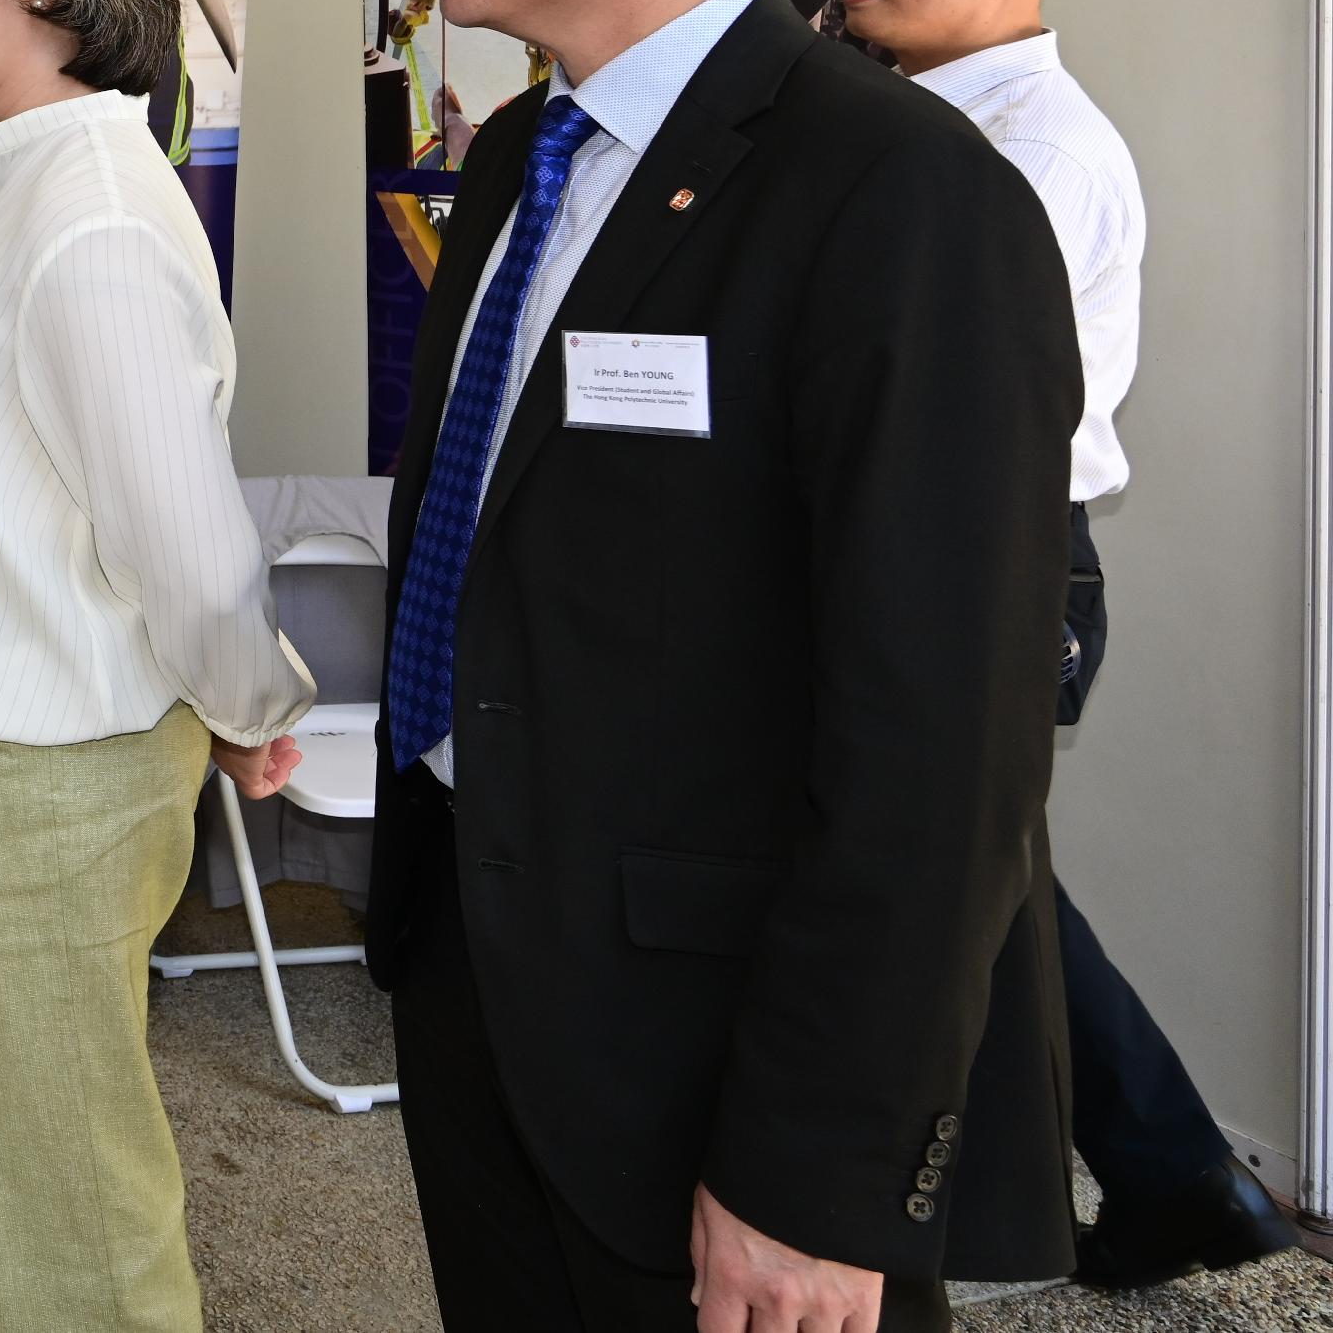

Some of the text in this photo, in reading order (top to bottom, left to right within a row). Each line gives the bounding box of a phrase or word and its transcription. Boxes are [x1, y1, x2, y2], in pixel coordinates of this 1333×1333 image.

[594, 369, 674, 380] Ir Prof. Ben YOUNG
[589, 385, 614, 393] President
[653, 388, 671, 396] Global
[594, 394, 608, 402] Hong
[609, 395, 623, 403] Kong
[624, 396, 657, 404] Polytechnic
[658, 398, 688, 407] University
